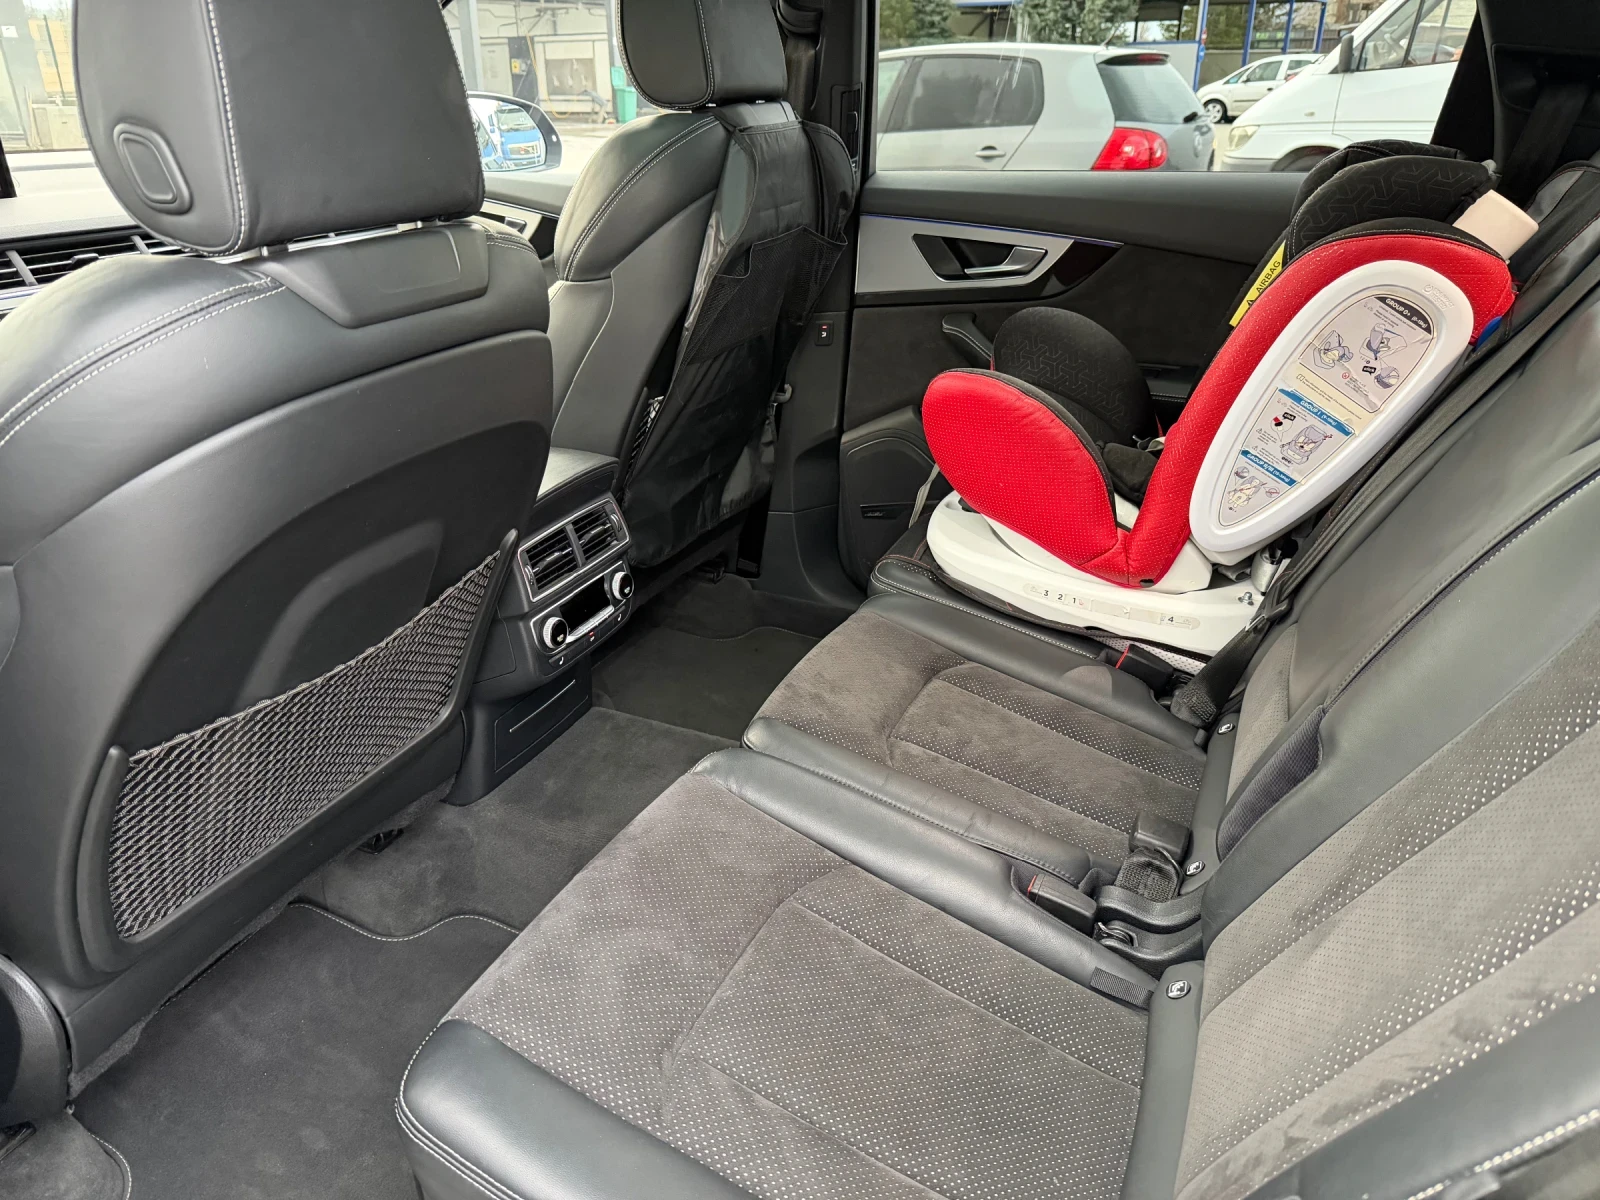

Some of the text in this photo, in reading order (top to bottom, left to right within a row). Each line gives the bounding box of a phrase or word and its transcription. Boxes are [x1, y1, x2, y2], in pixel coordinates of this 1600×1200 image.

[1256, 260, 1281, 294] AIRBAG
[1385, 298, 1405, 313] GROUP
[1300, 400, 1319, 413] GROUP
[1246, 453, 1265, 465] GROUP
[1043, 589, 1049, 597] 3
[1057, 593, 1063, 601] 2
